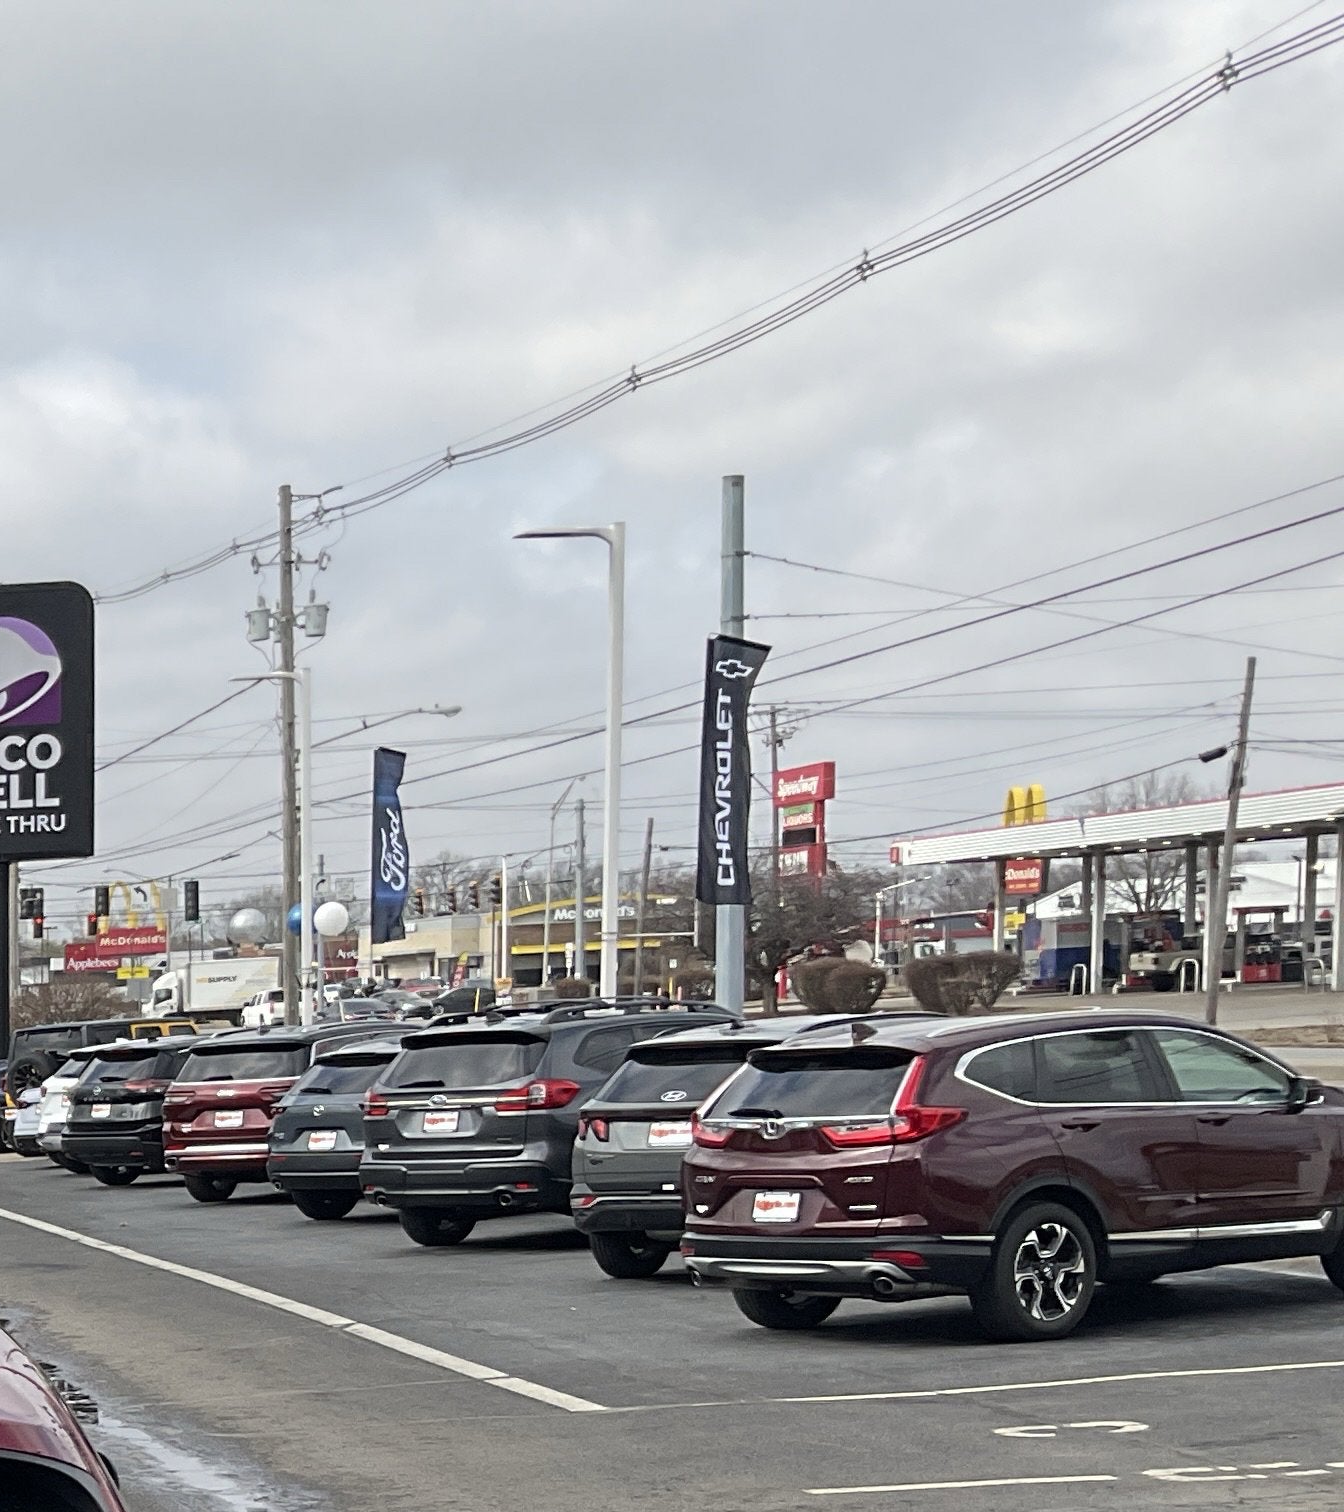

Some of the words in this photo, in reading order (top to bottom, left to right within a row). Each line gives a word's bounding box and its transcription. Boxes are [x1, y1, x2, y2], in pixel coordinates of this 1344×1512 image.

[715, 687, 735, 886] CHEVROLET
[778, 774, 820, 801] Speedway
[5, 813, 66, 835] THRU
[380, 807, 406, 891] Ford
